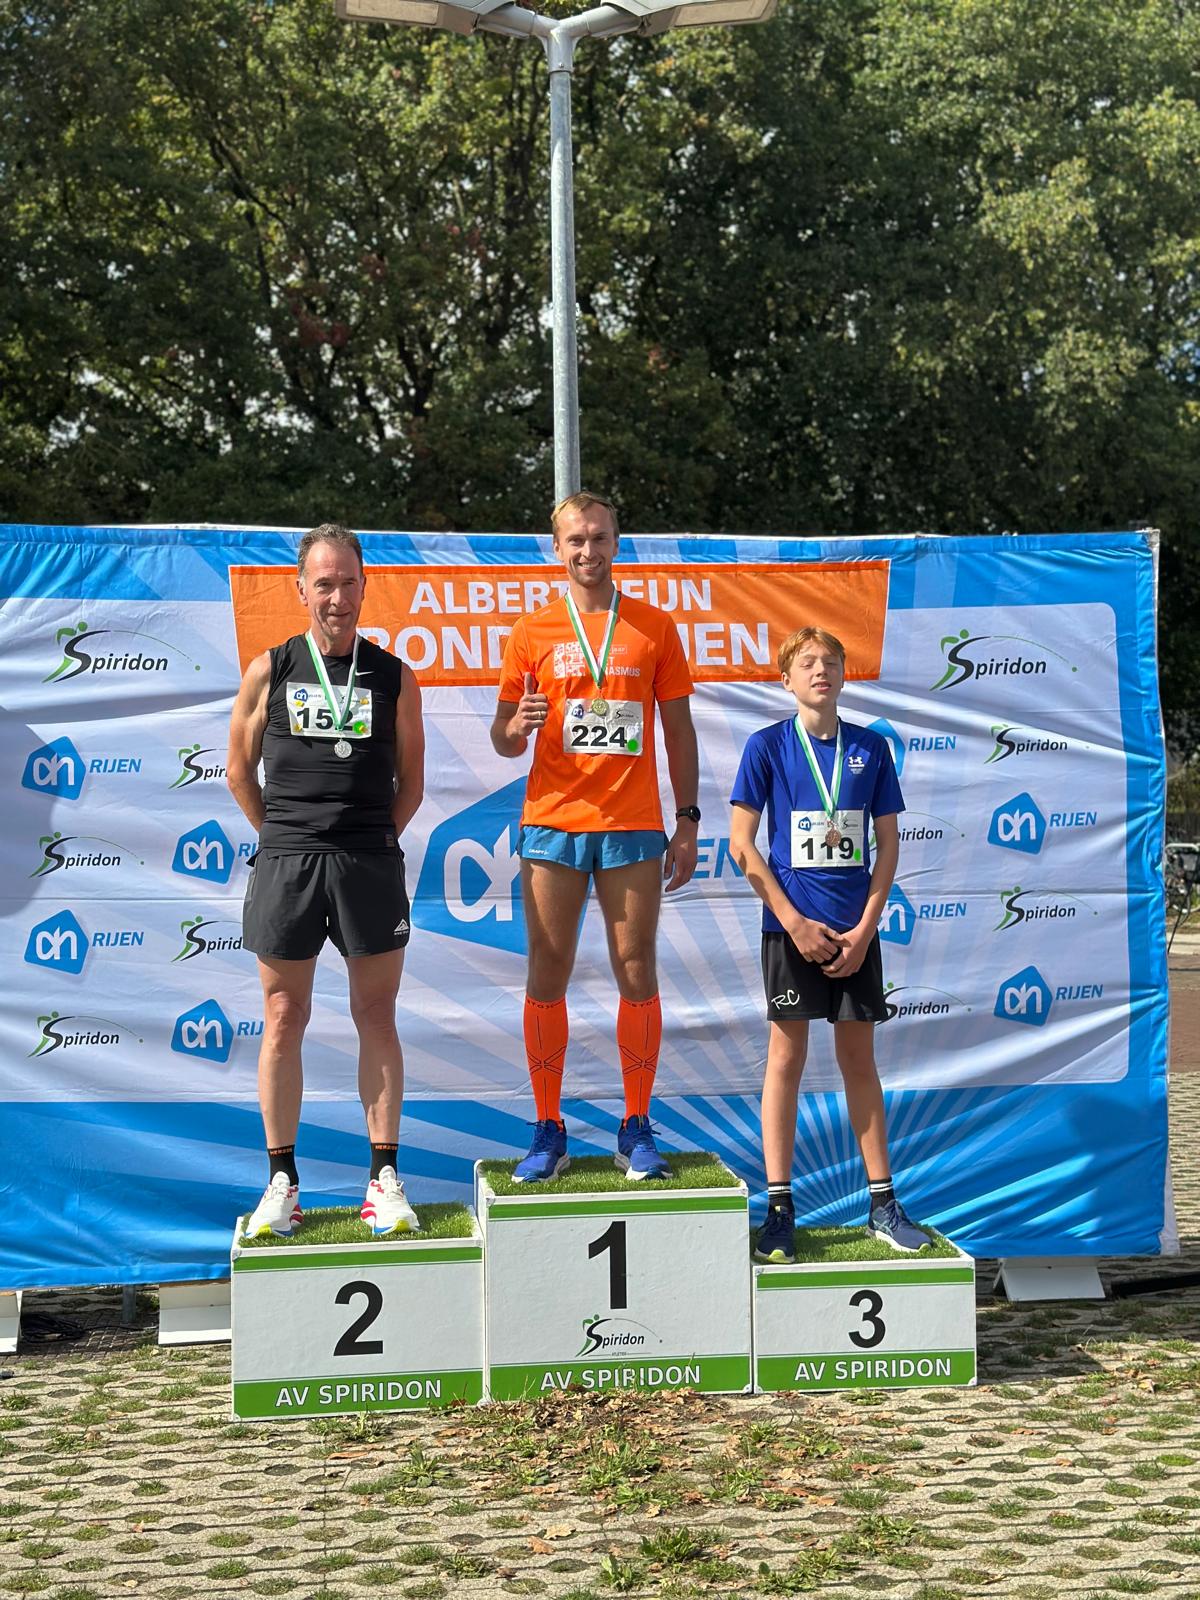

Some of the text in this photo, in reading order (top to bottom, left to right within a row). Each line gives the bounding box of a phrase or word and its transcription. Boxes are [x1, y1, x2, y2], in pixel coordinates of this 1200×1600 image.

[53, 630, 169, 683] Spiridon
[942, 636, 1047, 691] Spiridon
[571, 725, 627, 747] 224
[908, 736, 957, 752] RIJEN
[994, 727, 1067, 764] Spiridon
[89, 758, 142, 774] RIJEN
[1049, 811, 1098, 828] RIJEN
[39, 836, 121, 877] Spiridon
[801, 837, 854, 860] 119
[919, 903, 967, 919] RIJEN
[1001, 891, 1076, 931] Spiridon
[92, 932, 145, 947] RIJEN
[1056, 984, 1104, 1001] RIJEN
[38, 1016, 120, 1057] Spiridon
[237, 1021, 264, 1036] RIJ
[587, 1221, 628, 1310] 1
[333, 1280, 384, 1356] 2
[848, 1289, 886, 1348] 3
[581, 1318, 645, 1357] Spiridon
[540, 1365, 701, 1391] AV SPIRIDON
[794, 1357, 952, 1381] AV SPIRIDON
[275, 1379, 441, 1407] AV SPIRIDON
